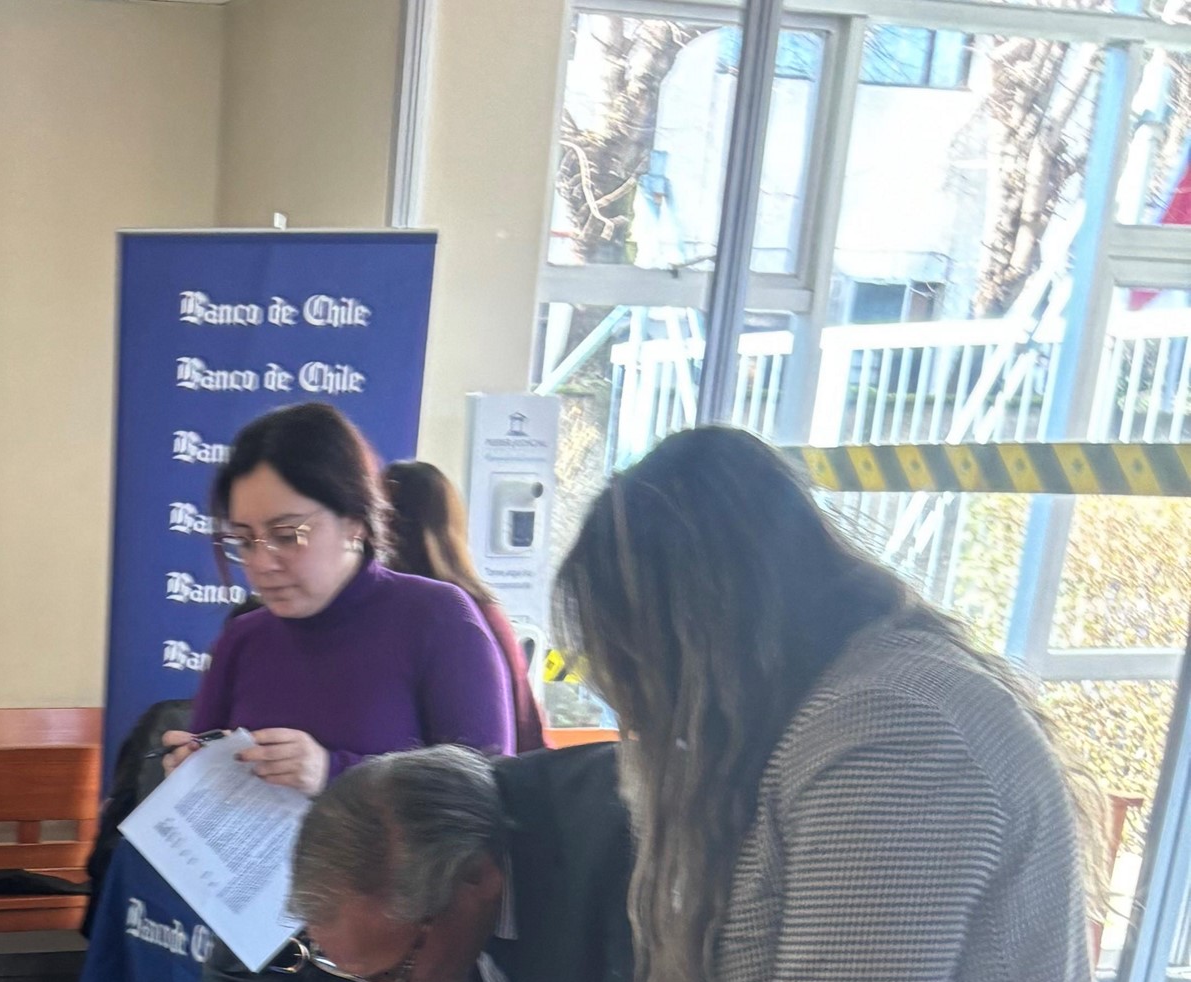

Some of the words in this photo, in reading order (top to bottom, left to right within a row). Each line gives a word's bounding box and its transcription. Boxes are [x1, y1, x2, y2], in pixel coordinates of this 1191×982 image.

[179, 290, 262, 325] Banco
[267, 296, 299, 326] de
[303, 294, 371, 328] Chile
[176, 357, 259, 391] Banco
[264, 362, 294, 392] de
[298, 361, 365, 394] Chile
[172, 430, 232, 464] Ban
[165, 571, 247, 604] Banco
[162, 639, 213, 672] Ban
